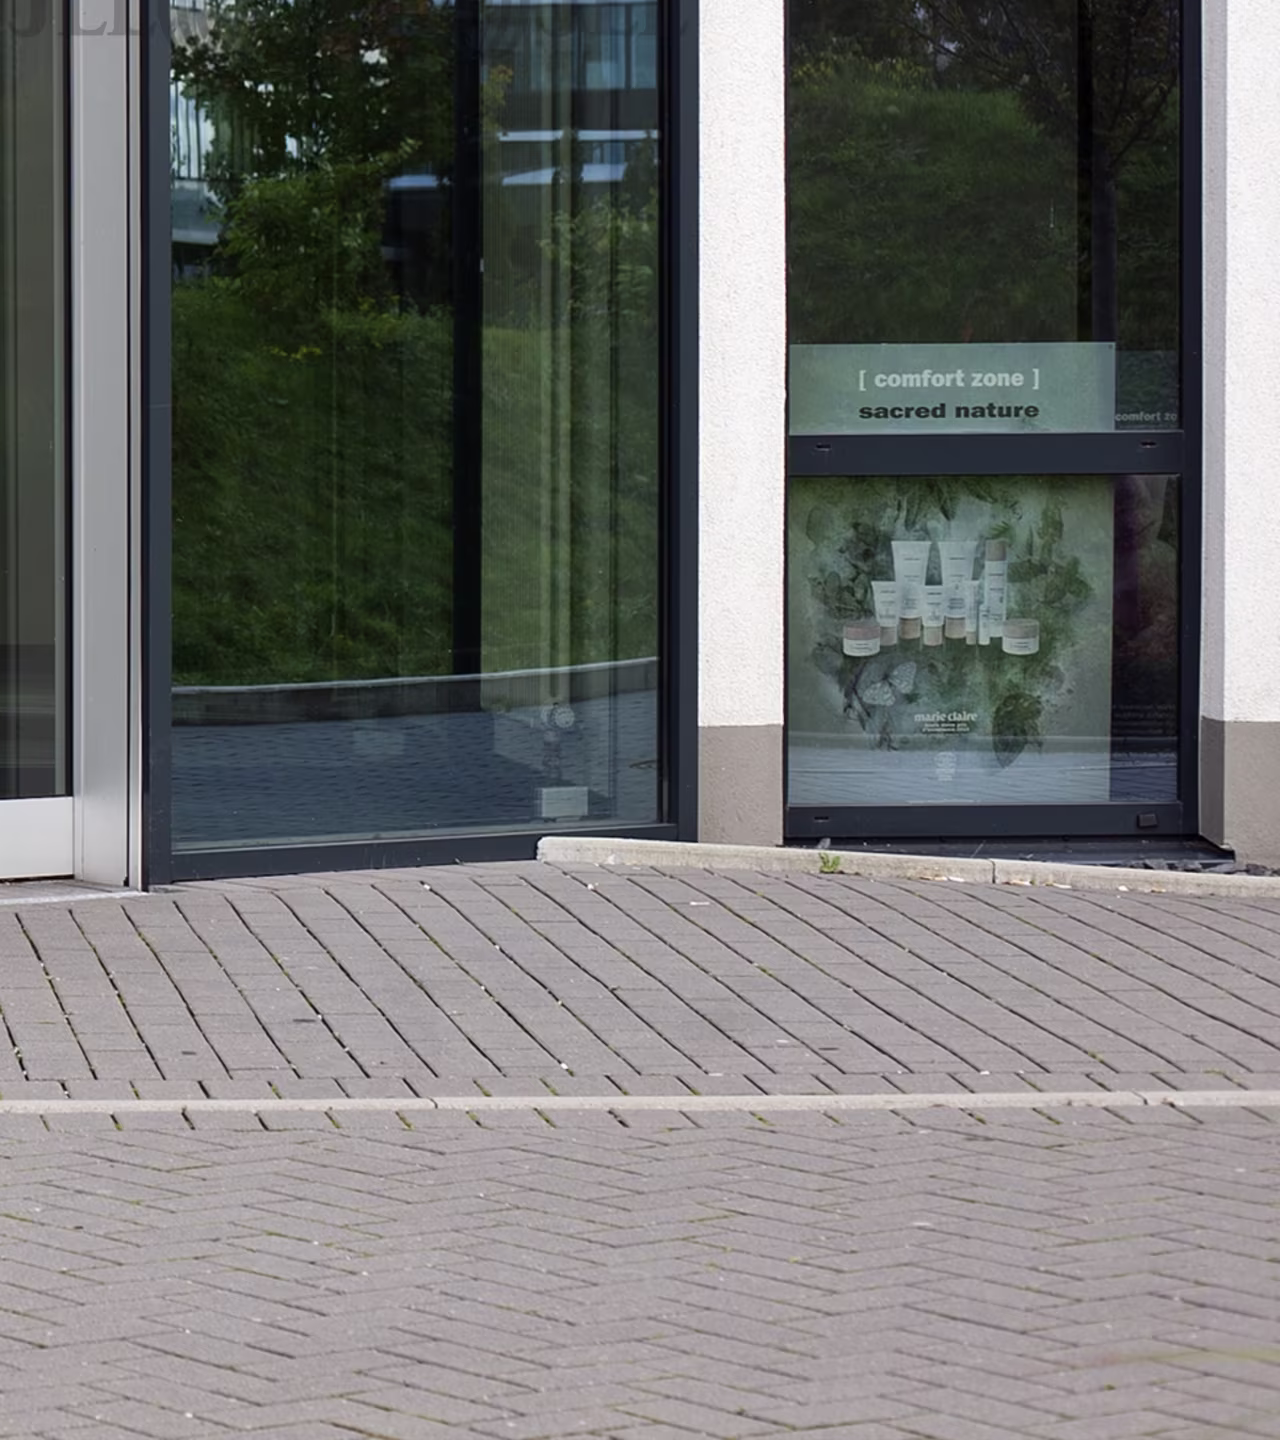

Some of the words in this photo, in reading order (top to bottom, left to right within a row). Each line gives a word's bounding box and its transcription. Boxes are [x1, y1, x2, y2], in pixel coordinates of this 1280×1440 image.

[874, 369, 965, 388] comfort
[971, 370, 1025, 387] zone
[858, 403, 946, 419] sacred
[955, 402, 1040, 418] nature
[1114, 411, 1162, 422] comfort
[914, 710, 947, 722] marie
[948, 710, 978, 722] claire
